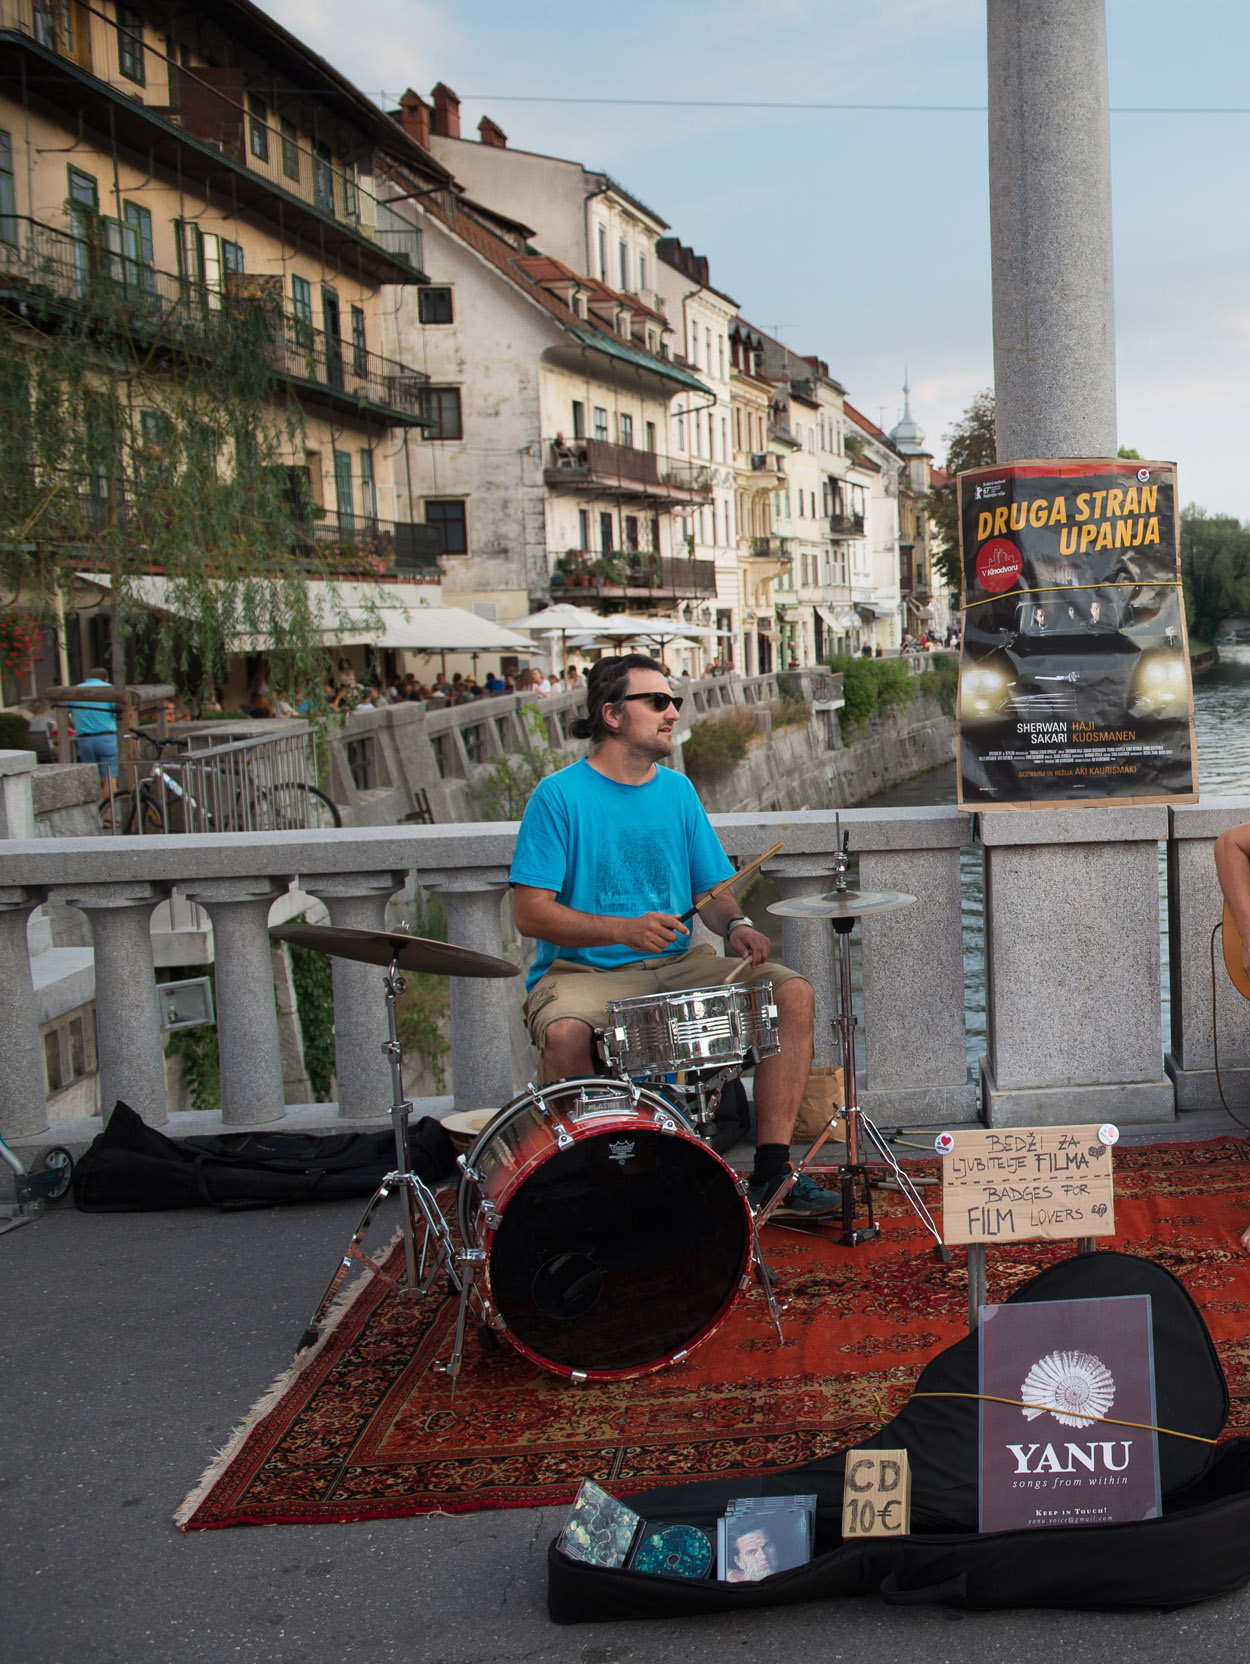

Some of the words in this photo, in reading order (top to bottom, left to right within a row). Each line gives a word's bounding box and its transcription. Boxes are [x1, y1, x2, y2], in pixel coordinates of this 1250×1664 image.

[977, 497, 1067, 541] DRUGA
[1075, 485, 1158, 522] STRAN
[1059, 517, 1160, 556] UPANJA
[987, 564, 1018, 577] Kinodvoru
[1017, 722, 1067, 733] SHERWAN
[1072, 721, 1095, 731] HAJI
[1031, 733, 1067, 744] SAKARI
[1072, 731, 1136, 742] KUOSMANEN
[1074, 767, 1087, 776] AKI
[1089, 765, 1137, 775] KAURISMÄKI
[985, 1132, 1043, 1154] BEDŽI
[1058, 1134, 1080, 1150] ZA
[952, 1155, 1027, 1180] LJUBITELJE
[1034, 1152, 1089, 1173] FILMA
[982, 1186, 1053, 1205] BADGES
[1061, 1184, 1090, 1196] FOR
[968, 1206, 1015, 1236] FILM
[1030, 1208, 1083, 1226] LOVERS
[1005, 1441, 1133, 1473] YANU
[848, 1459, 901, 1493] CD
[1012, 1479, 1048, 1489] songs
[1052, 1477, 1082, 1489] from
[1088, 1475, 1128, 1486] within
[846, 1498, 902, 1534] 10€
[1027, 1515, 1113, 1526] yanu.voice@gmail.com
